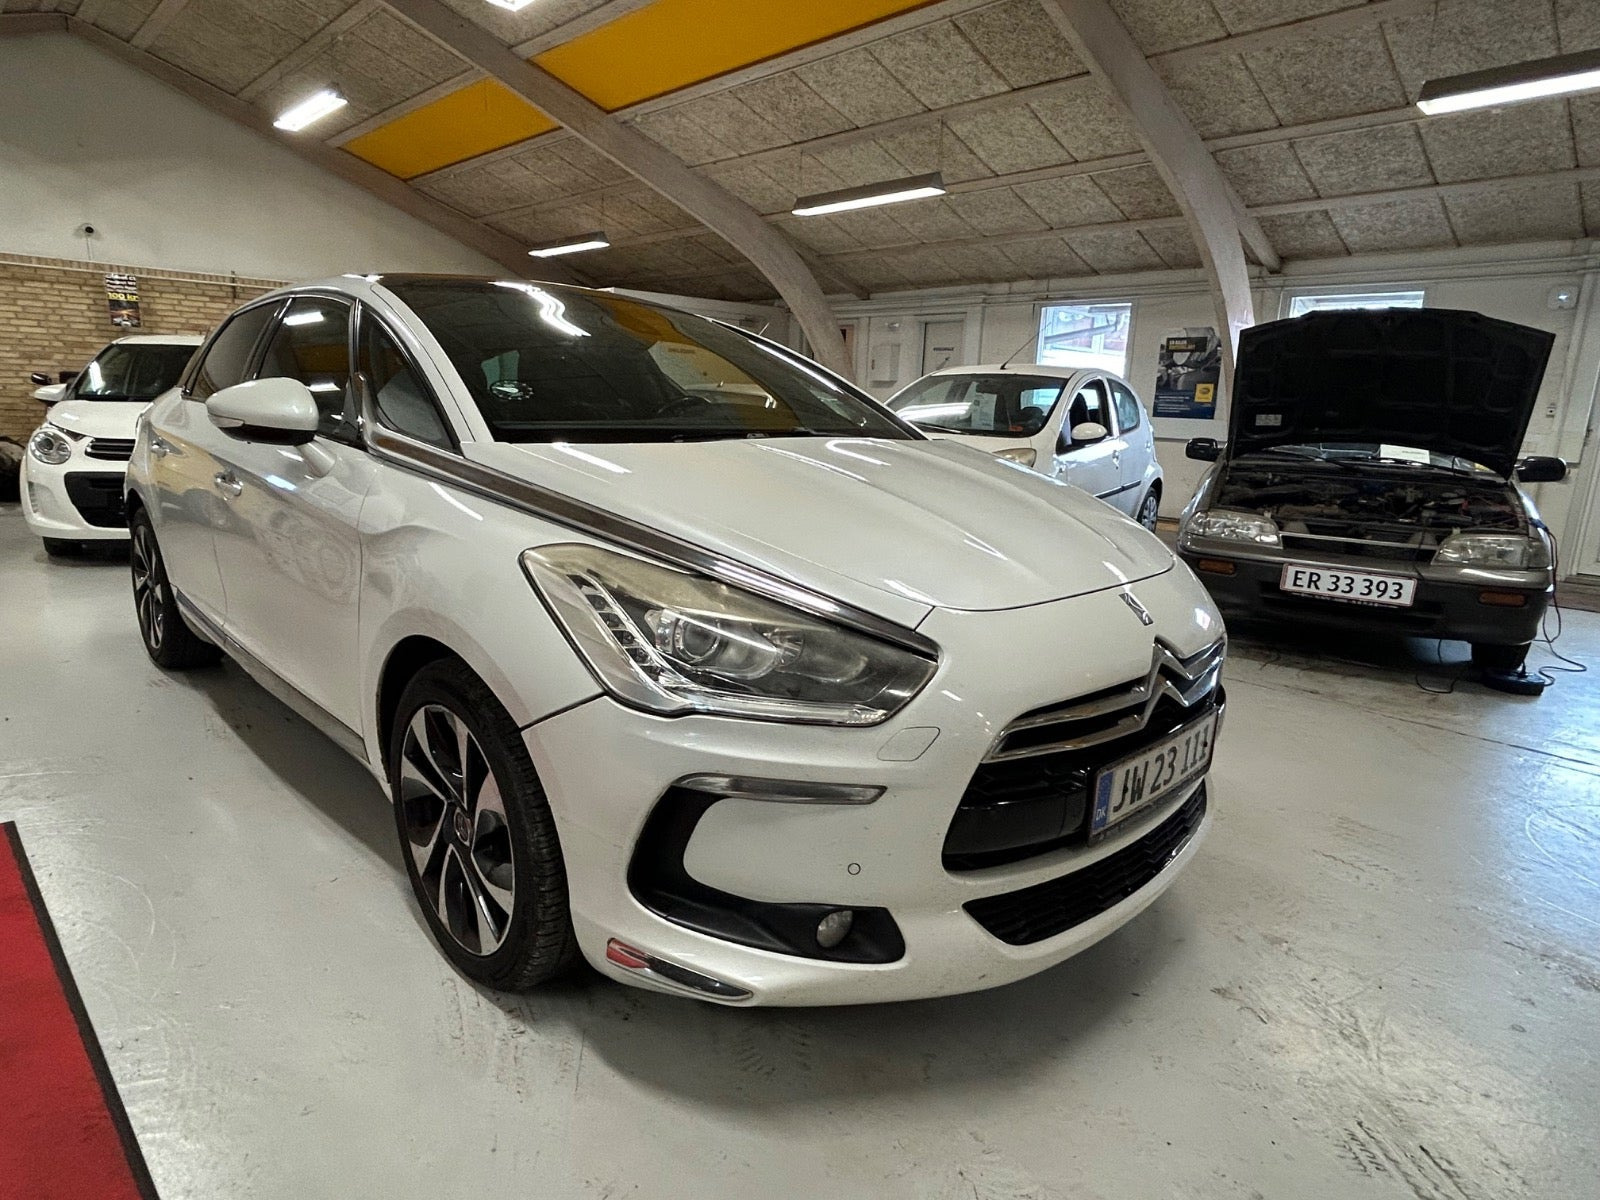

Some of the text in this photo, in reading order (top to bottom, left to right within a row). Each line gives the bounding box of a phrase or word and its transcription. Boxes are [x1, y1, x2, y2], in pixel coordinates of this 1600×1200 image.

[107, 292, 125, 300] 100
[1292, 570, 1321, 590] ER
[1327, 574, 1355, 594] 33
[1359, 578, 1403, 600] 393
[1113, 724, 1209, 813] JW 23 111
[1096, 808, 1106, 821] DK
